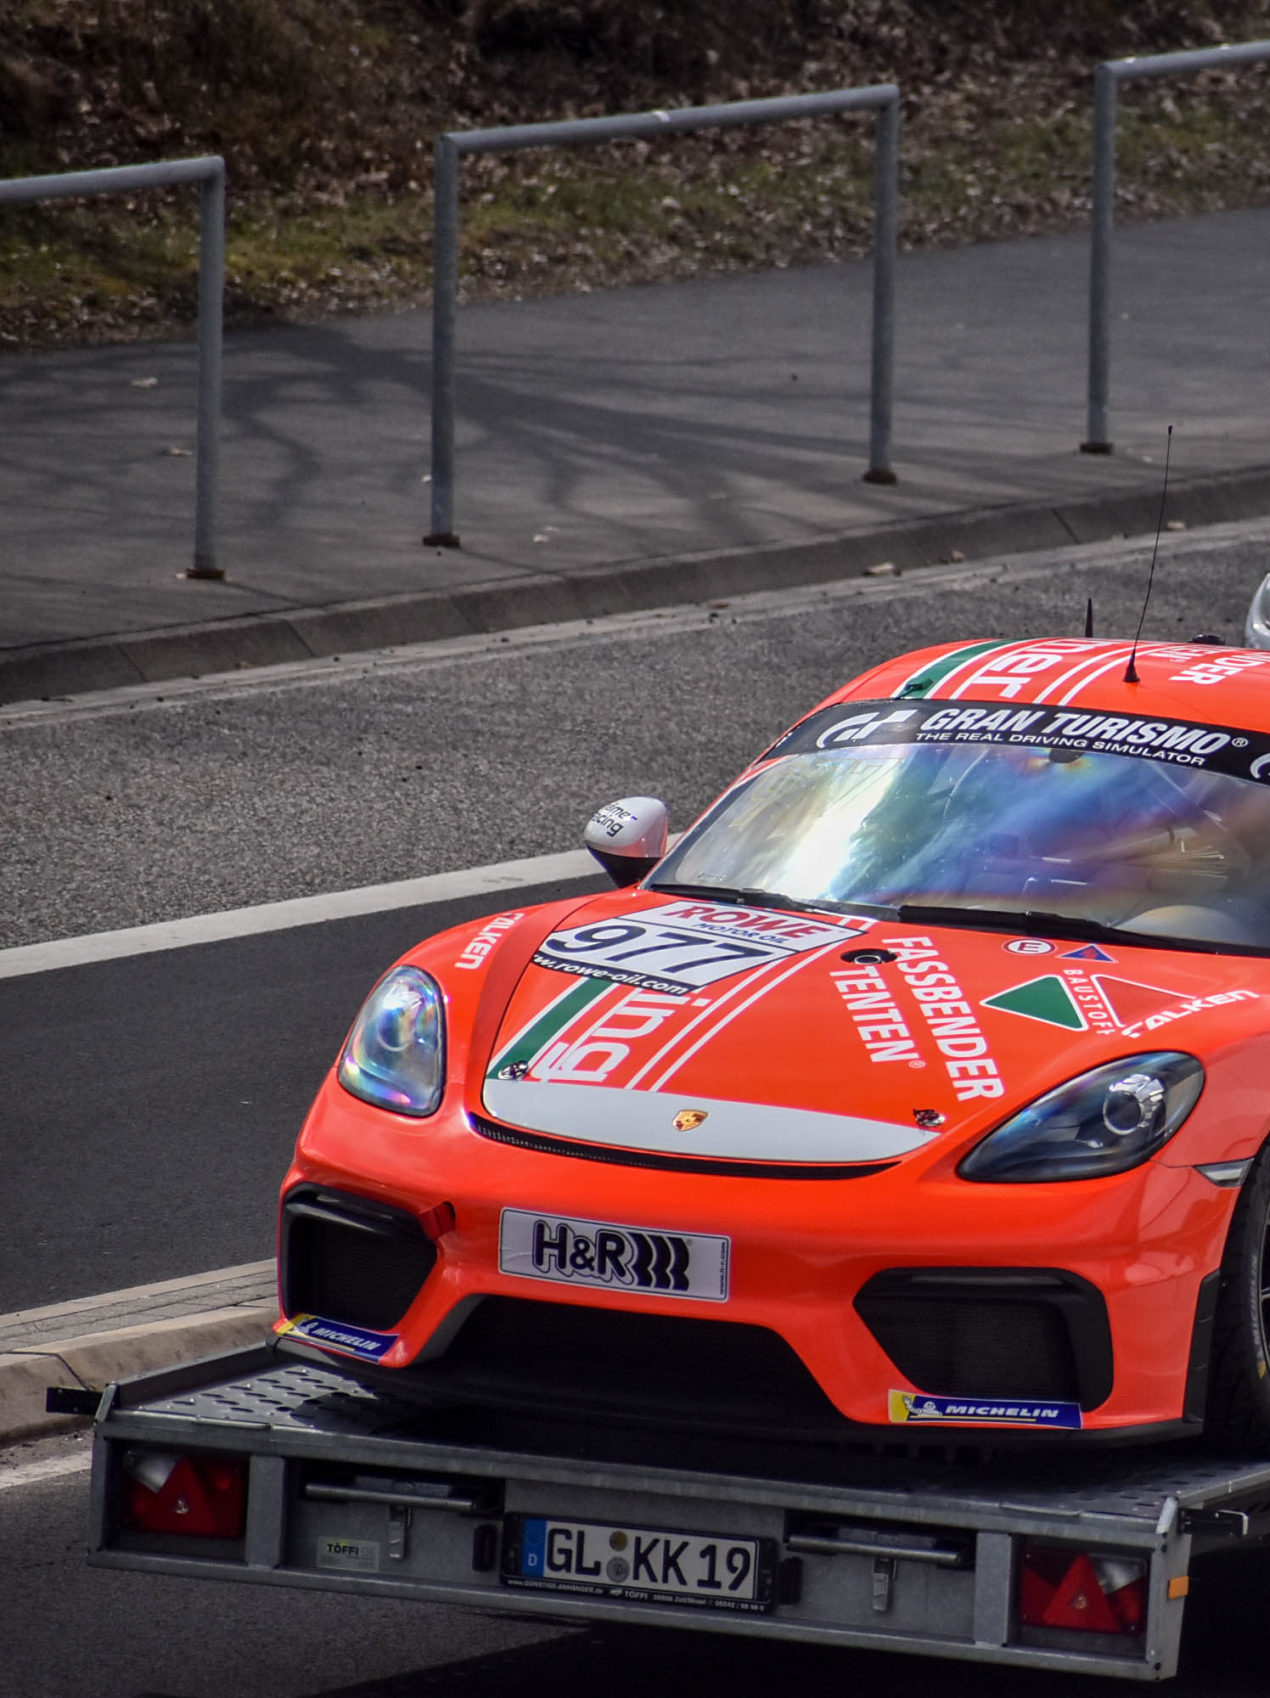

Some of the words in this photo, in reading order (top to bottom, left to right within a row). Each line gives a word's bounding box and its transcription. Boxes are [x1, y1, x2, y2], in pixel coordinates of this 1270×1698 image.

[920, 709, 1046, 732] GRAN
[916, 732, 950, 742] THE
[952, 732, 1004, 742] REAL
[1008, 734, 1088, 749] DRIVING
[1091, 740, 1206, 766] SIMULATOR
[662, 905, 832, 940] ROWE
[691, 922, 760, 940] MOTOR
[757, 934, 787, 944] OIL
[455, 912, 525, 970] FALKEN
[546, 925, 772, 974] 977
[881, 936, 1005, 1102] FASSBENDER
[1121, 989, 1261, 1039] FALKEN
[533, 1220, 632, 1284] H&R
[311, 1327, 382, 1351] MICHELIN
[945, 1404, 1059, 1418] MICHELIN
[527, 1553, 538, 1567] D
[546, 1528, 601, 1576] GL
[632, 1536, 690, 1586] KK
[696, 1544, 751, 1592] 19
